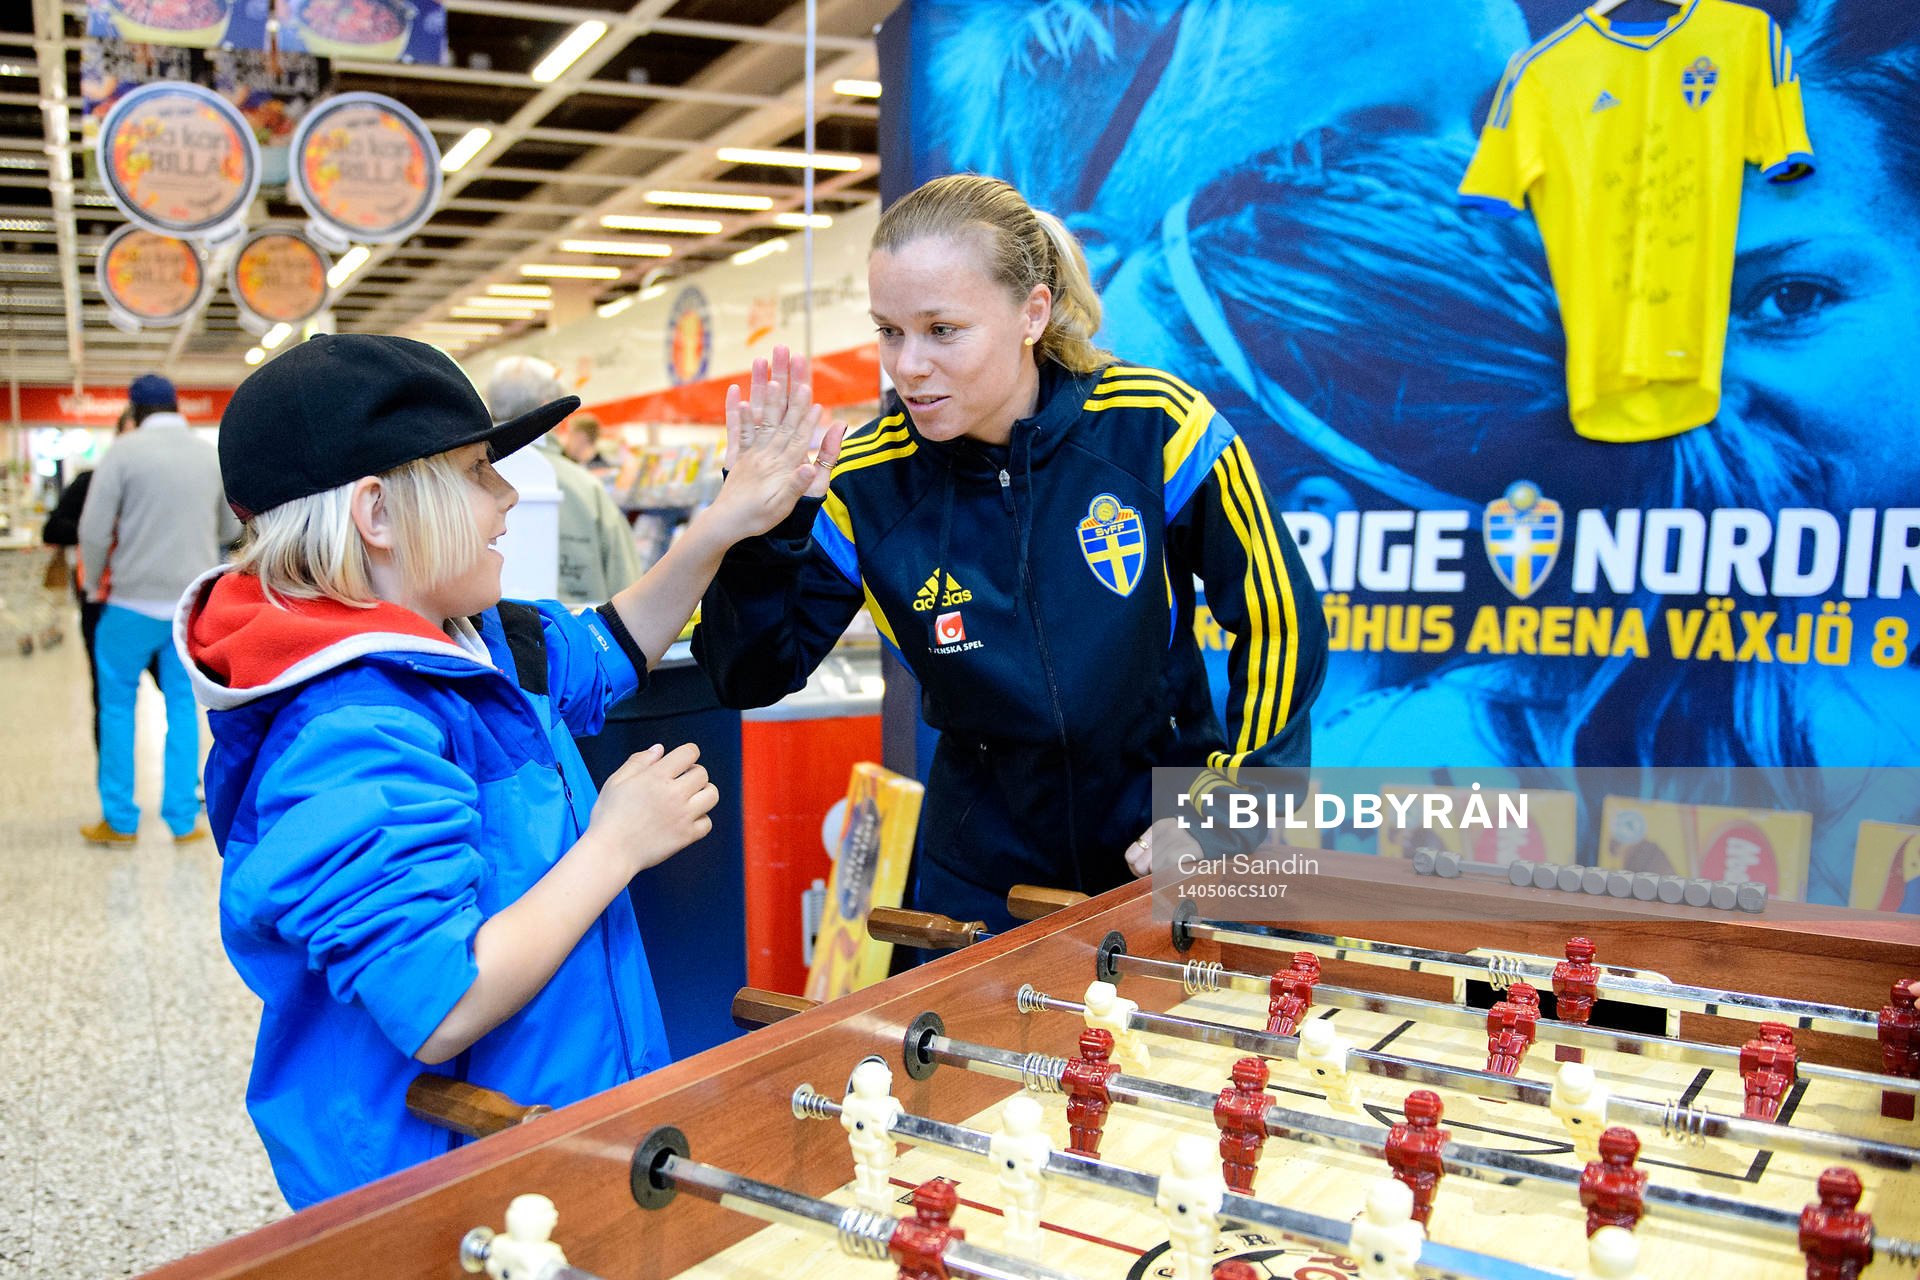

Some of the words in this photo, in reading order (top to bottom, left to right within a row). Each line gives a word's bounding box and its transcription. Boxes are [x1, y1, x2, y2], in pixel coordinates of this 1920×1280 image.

[1281, 510, 1470, 592] RIGE
[963, 640, 985, 652] SPEL
[1465, 605, 1650, 658] ARENA
[1665, 596, 1854, 667] VÄXJÖ
[1871, 616, 1910, 669] 8
